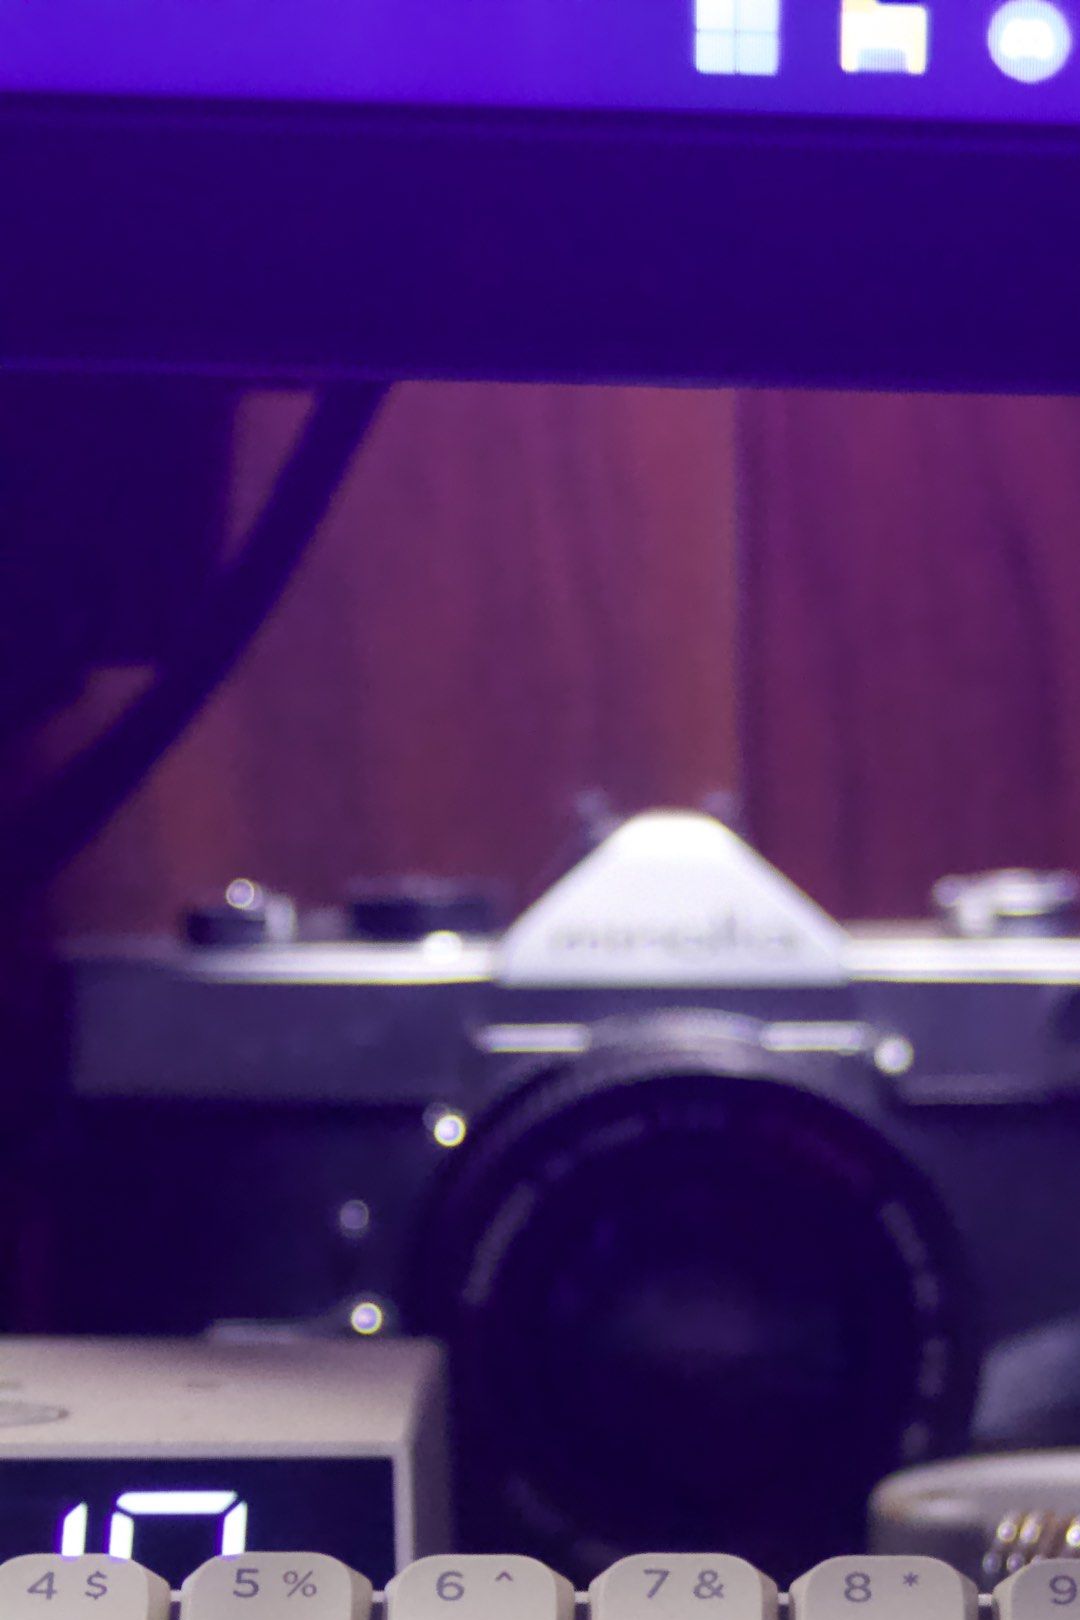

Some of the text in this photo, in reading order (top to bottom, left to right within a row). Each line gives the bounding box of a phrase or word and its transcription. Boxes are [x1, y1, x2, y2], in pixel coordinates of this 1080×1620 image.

[26, 1570, 58, 1601] 4
[232, 1567, 260, 1599] 5
[435, 1569, 465, 1602] 6
[642, 1568, 671, 1599] 7
[843, 1570, 873, 1604] 8
[1048, 1574, 1078, 1606] 9
